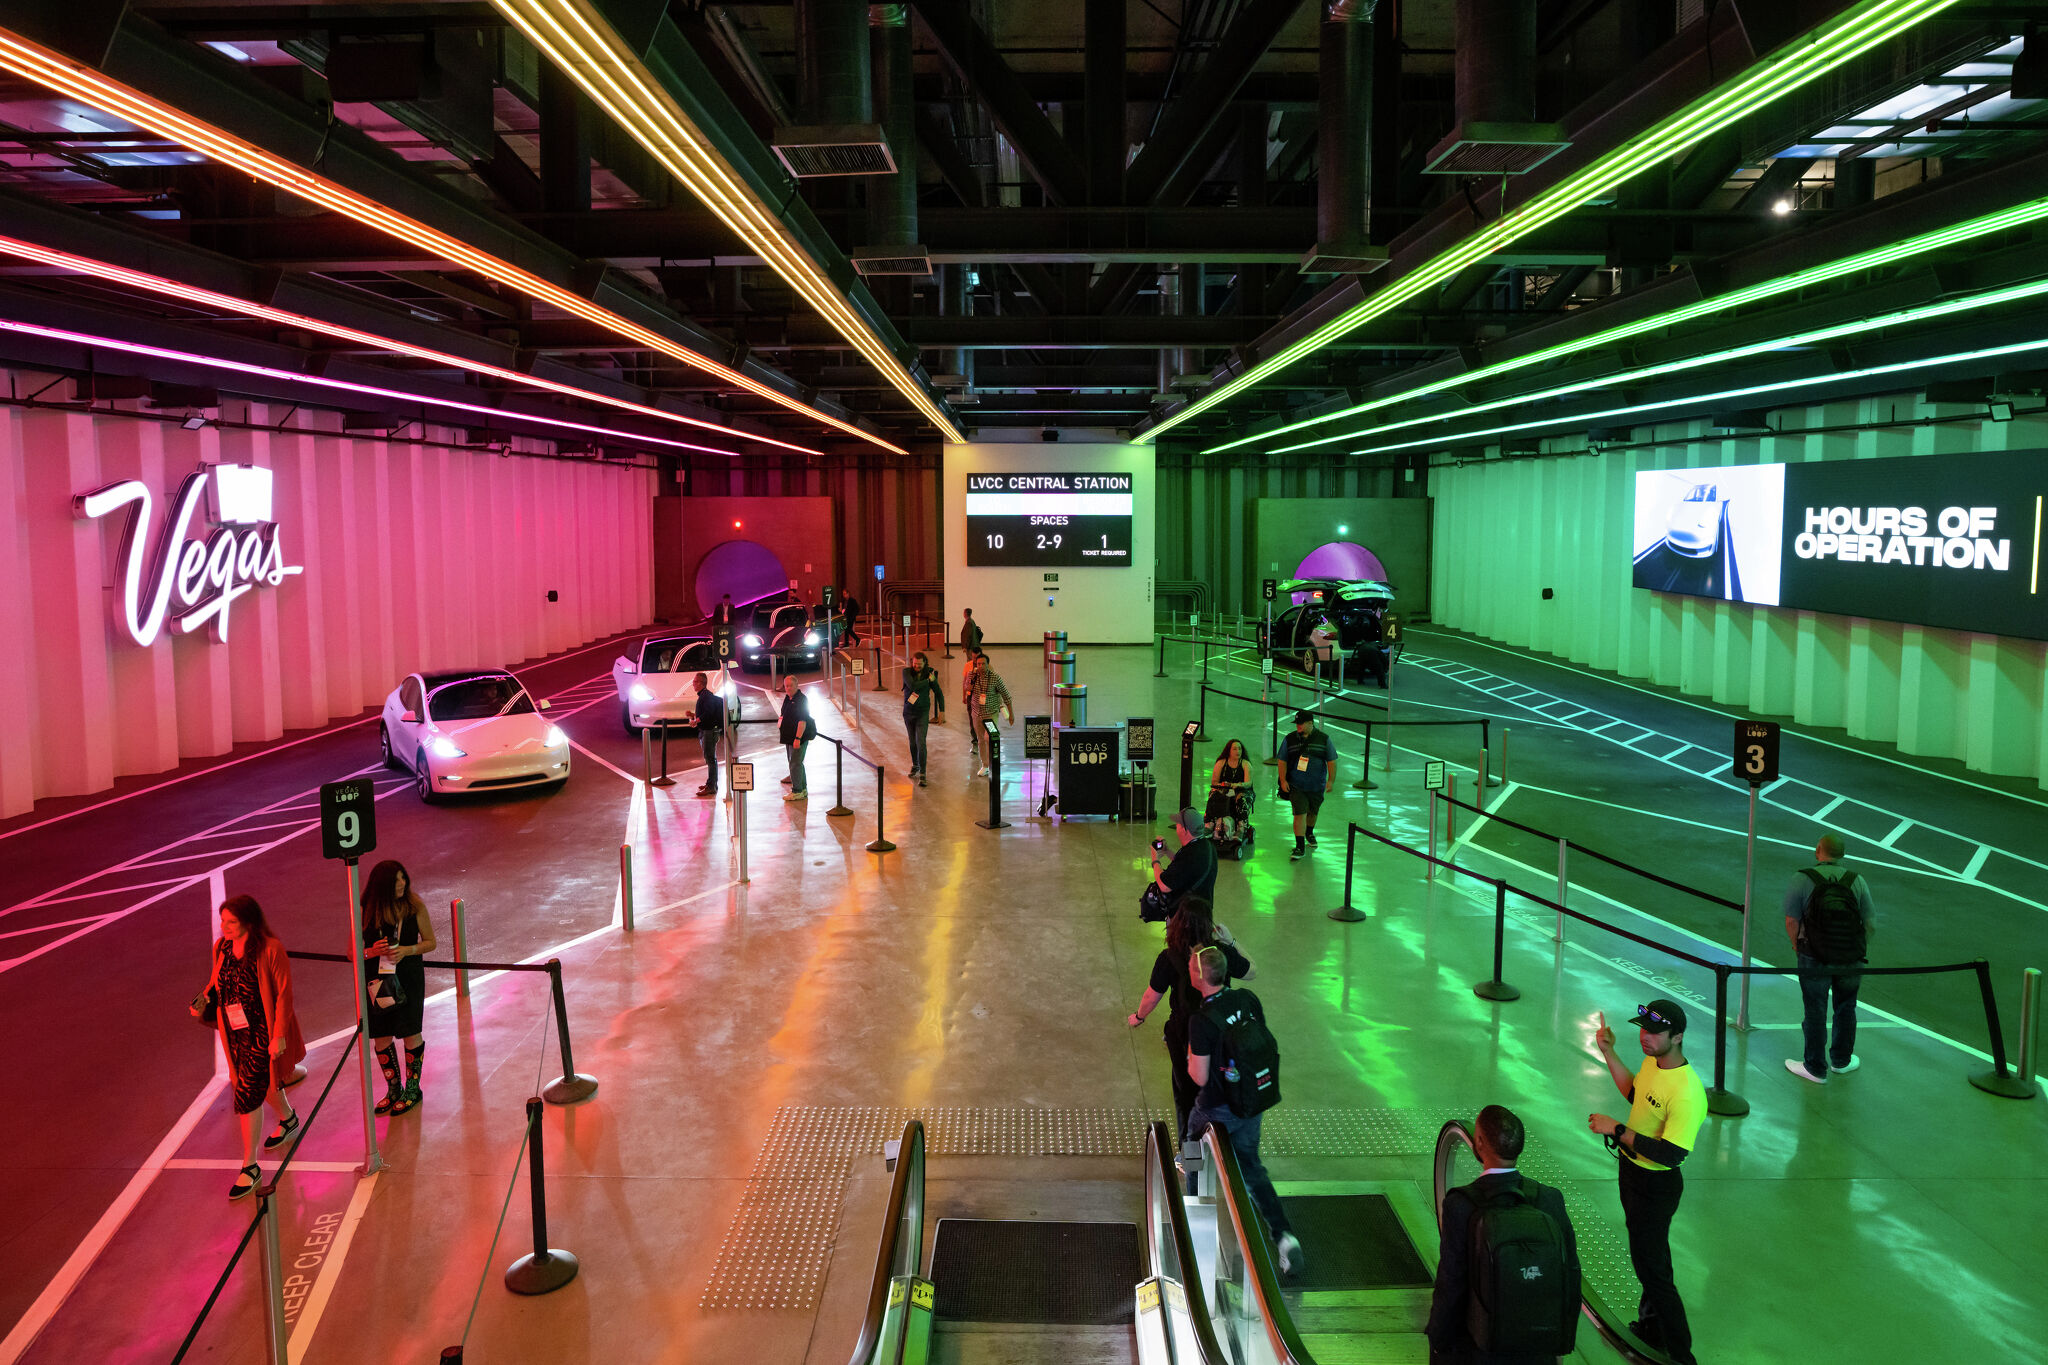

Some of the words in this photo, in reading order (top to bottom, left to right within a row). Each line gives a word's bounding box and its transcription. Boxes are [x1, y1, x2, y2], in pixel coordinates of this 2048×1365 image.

[970, 477, 1004, 489] LVCC
[1008, 477, 1070, 489] CENTRAL
[1074, 477, 1129, 489] STATION
[1030, 516, 1069, 526] SPACES
[1804, 506, 1928, 536] HOURS
[1937, 506, 1997, 538] OF
[986, 534, 1004, 549] 10
[1036, 534, 1062, 549] 2-9
[1101, 534, 1107, 549] 1
[1794, 532, 2011, 571] OPERATION
[84, 472, 304, 647] Vegas
[825, 593, 832, 605] 7
[1266, 587, 1273, 597] 5
[1387, 624, 1397, 639] 4
[719, 639, 729, 656] 8
[1747, 730, 1768, 738] LOOP
[1070, 743, 1108, 752] VEGAS
[1070, 752, 1108, 765] LOOP
[1745, 744, 1765, 774] 3
[335, 786, 360, 795] VEGAS
[335, 792, 360, 803] LOOP
[337, 811, 360, 848] 9
[1610, 957, 1654, 976] KEEP
[1651, 976, 1707, 1001] CLEAR
[293, 1211, 343, 1269] CLEAR
